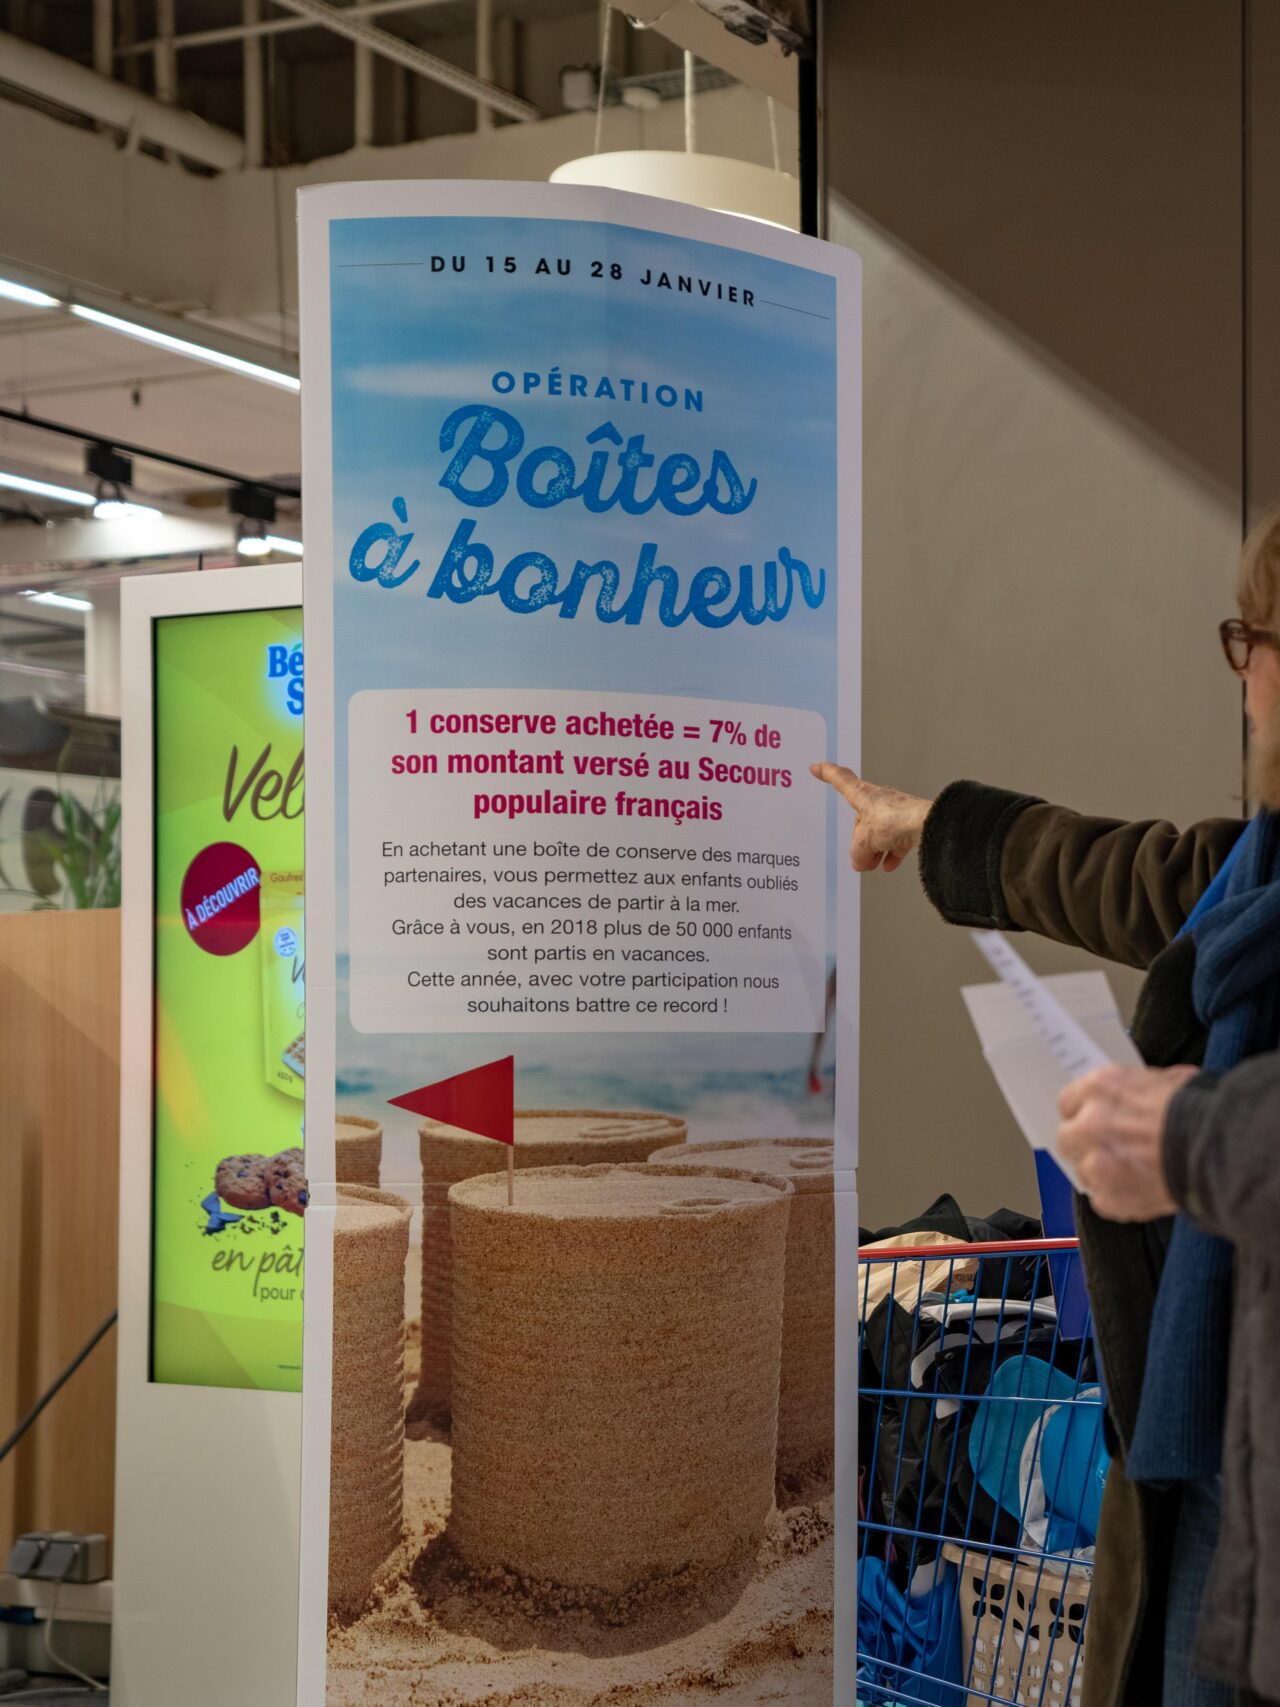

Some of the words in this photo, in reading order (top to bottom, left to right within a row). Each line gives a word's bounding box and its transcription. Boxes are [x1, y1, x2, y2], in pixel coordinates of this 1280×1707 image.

[430, 255, 466, 273] DU
[485, 255, 517, 274] 15
[534, 257, 571, 276] AU
[590, 260, 623, 281] 28
[639, 268, 755, 308] JANVIER
[491, 366, 704, 412] OPÉRATION
[438, 403, 758, 517] Boîtes
[349, 496, 421, 589] à
[426, 518, 826, 629] bonheur
[405, 708, 418, 734] 1
[429, 713, 557, 735] conserve
[565, 711, 675, 740] achetée
[682, 725, 701, 740] =
[708, 719, 747, 746] 7%
[754, 723, 782, 750] de
[223, 741, 304, 822] Vel
[391, 753, 438, 775] son
[447, 748, 565, 775] montant
[572, 751, 650, 778] versé
[657, 759, 690, 780] au
[698, 756, 793, 789] Secours
[473, 788, 607, 820] populaire
[614, 790, 723, 826] français
[382, 841, 404, 858] En
[408, 840, 487, 857] achetant
[492, 844, 528, 857] une
[533, 840, 581, 858] boîte
[586, 841, 610, 858] de
[615, 846, 697, 861] conserve
[701, 846, 733, 863] des
[736, 851, 801, 869] marques
[383, 866, 487, 888] partenaires,
[492, 870, 538, 883] vous
[544, 868, 639, 887] permettez
[643, 872, 676, 886] aux
[681, 871, 743, 889] enfants
[746, 874, 799, 892] oubliés
[185, 908, 199, 930] À
[195, 867, 260, 923] DÉCOUVRIR
[453, 892, 487, 909] des
[492, 896, 582, 910] vacances
[587, 893, 612, 910] de
[617, 894, 666, 914] partir
[669, 895, 681, 912] à
[686, 895, 701, 912] la
[705, 900, 740, 913] mer.
[391, 918, 445, 936] Grâce
[449, 918, 461, 935] à
[466, 922, 516, 937] vous,
[521, 922, 545, 935] en
[550, 918, 598, 936] 2018
[603, 919, 643, 939] plus
[647, 920, 671, 937] de
[675, 921, 698, 937] 50
[702, 921, 734, 938] 000
[737, 923, 793, 940] enfants
[487, 945, 529, 961] sont
[534, 944, 587, 965] partis
[592, 948, 615, 961] en
[620, 949, 710, 963] vacances.
[407, 970, 456, 988] Cette
[460, 970, 522, 989] année,
[528, 974, 573, 987] avec
[578, 971, 626, 987] votre
[631, 971, 738, 992] participation
[743, 976, 780, 989] nous
[467, 996, 570, 1014] souhaitons
[575, 996, 631, 1013] battre
[635, 1000, 658, 1013] ce
[663, 997, 718, 1014] record
[723, 997, 728, 1013] !
[211, 1249, 255, 1272] en
[259, 1286, 296, 1302] pour
